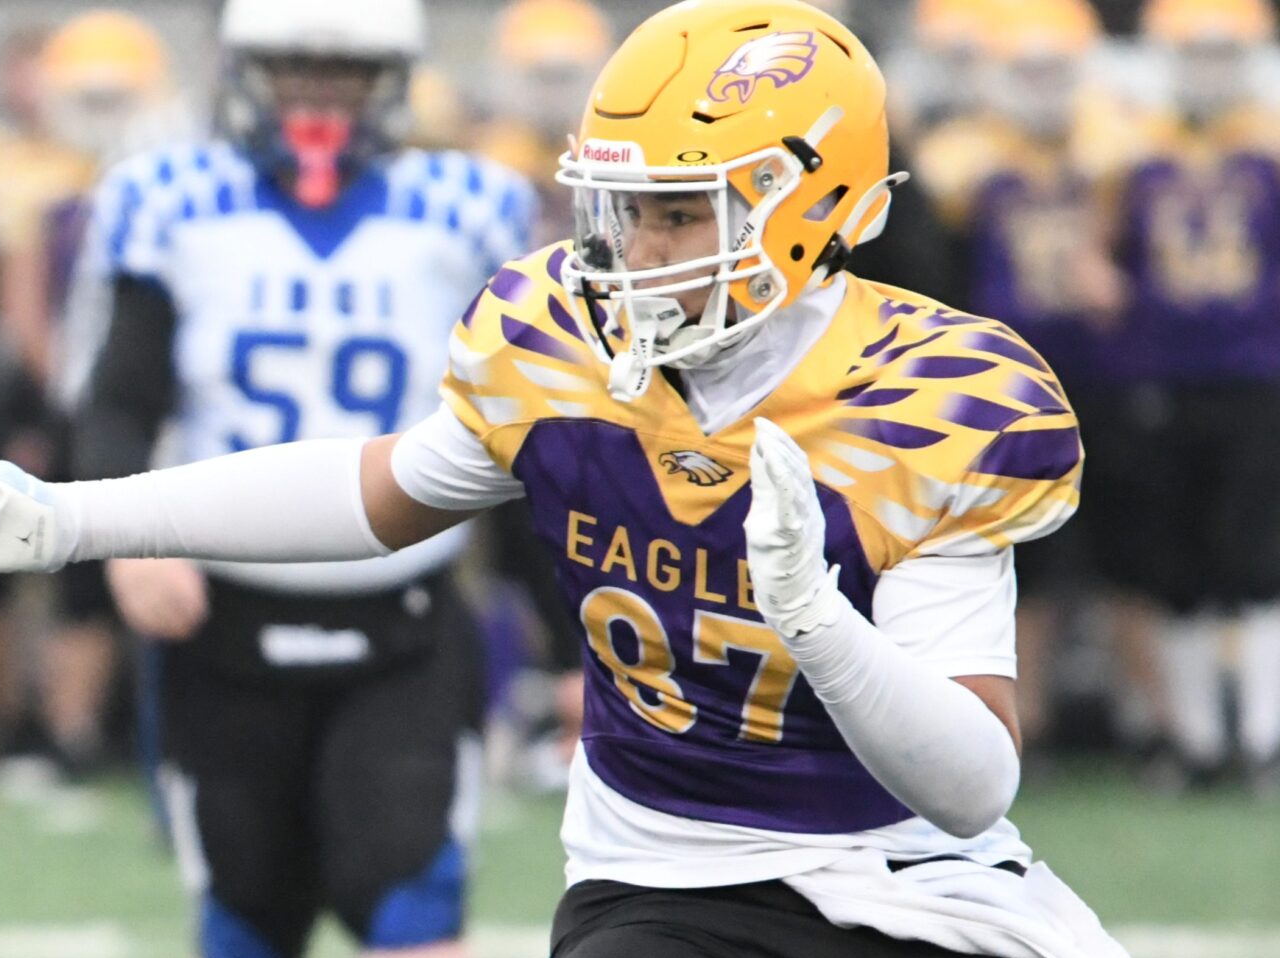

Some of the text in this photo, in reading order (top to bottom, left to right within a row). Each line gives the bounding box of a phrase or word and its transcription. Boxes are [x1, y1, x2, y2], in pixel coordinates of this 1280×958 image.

[583, 144, 631, 163] Riddell
[229, 331, 408, 453] 59
[579, 585, 800, 744] 87
